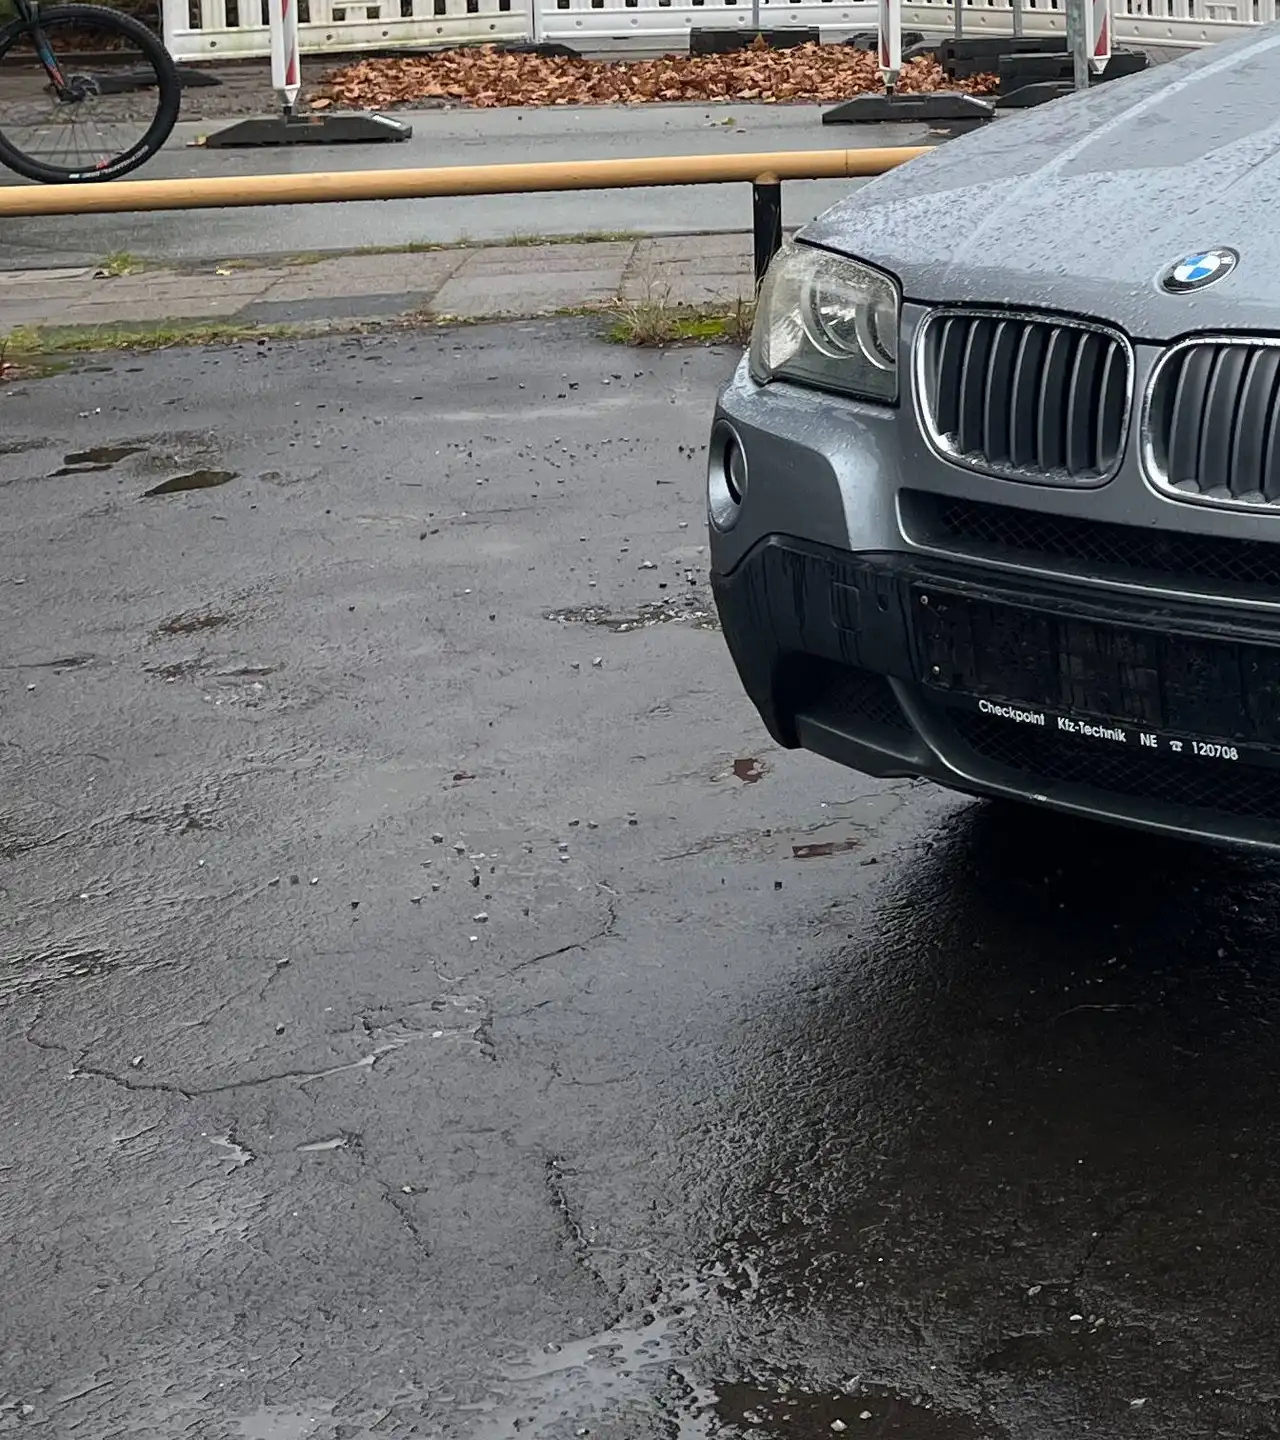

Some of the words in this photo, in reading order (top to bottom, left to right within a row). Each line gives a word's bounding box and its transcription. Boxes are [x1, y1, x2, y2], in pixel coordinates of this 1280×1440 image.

[978, 699, 1045, 726] Checkpoint
[1057, 716, 1127, 743] Kfz-Technik
[1139, 732, 1158, 748] NE
[1191, 740, 1239, 761] 120708
